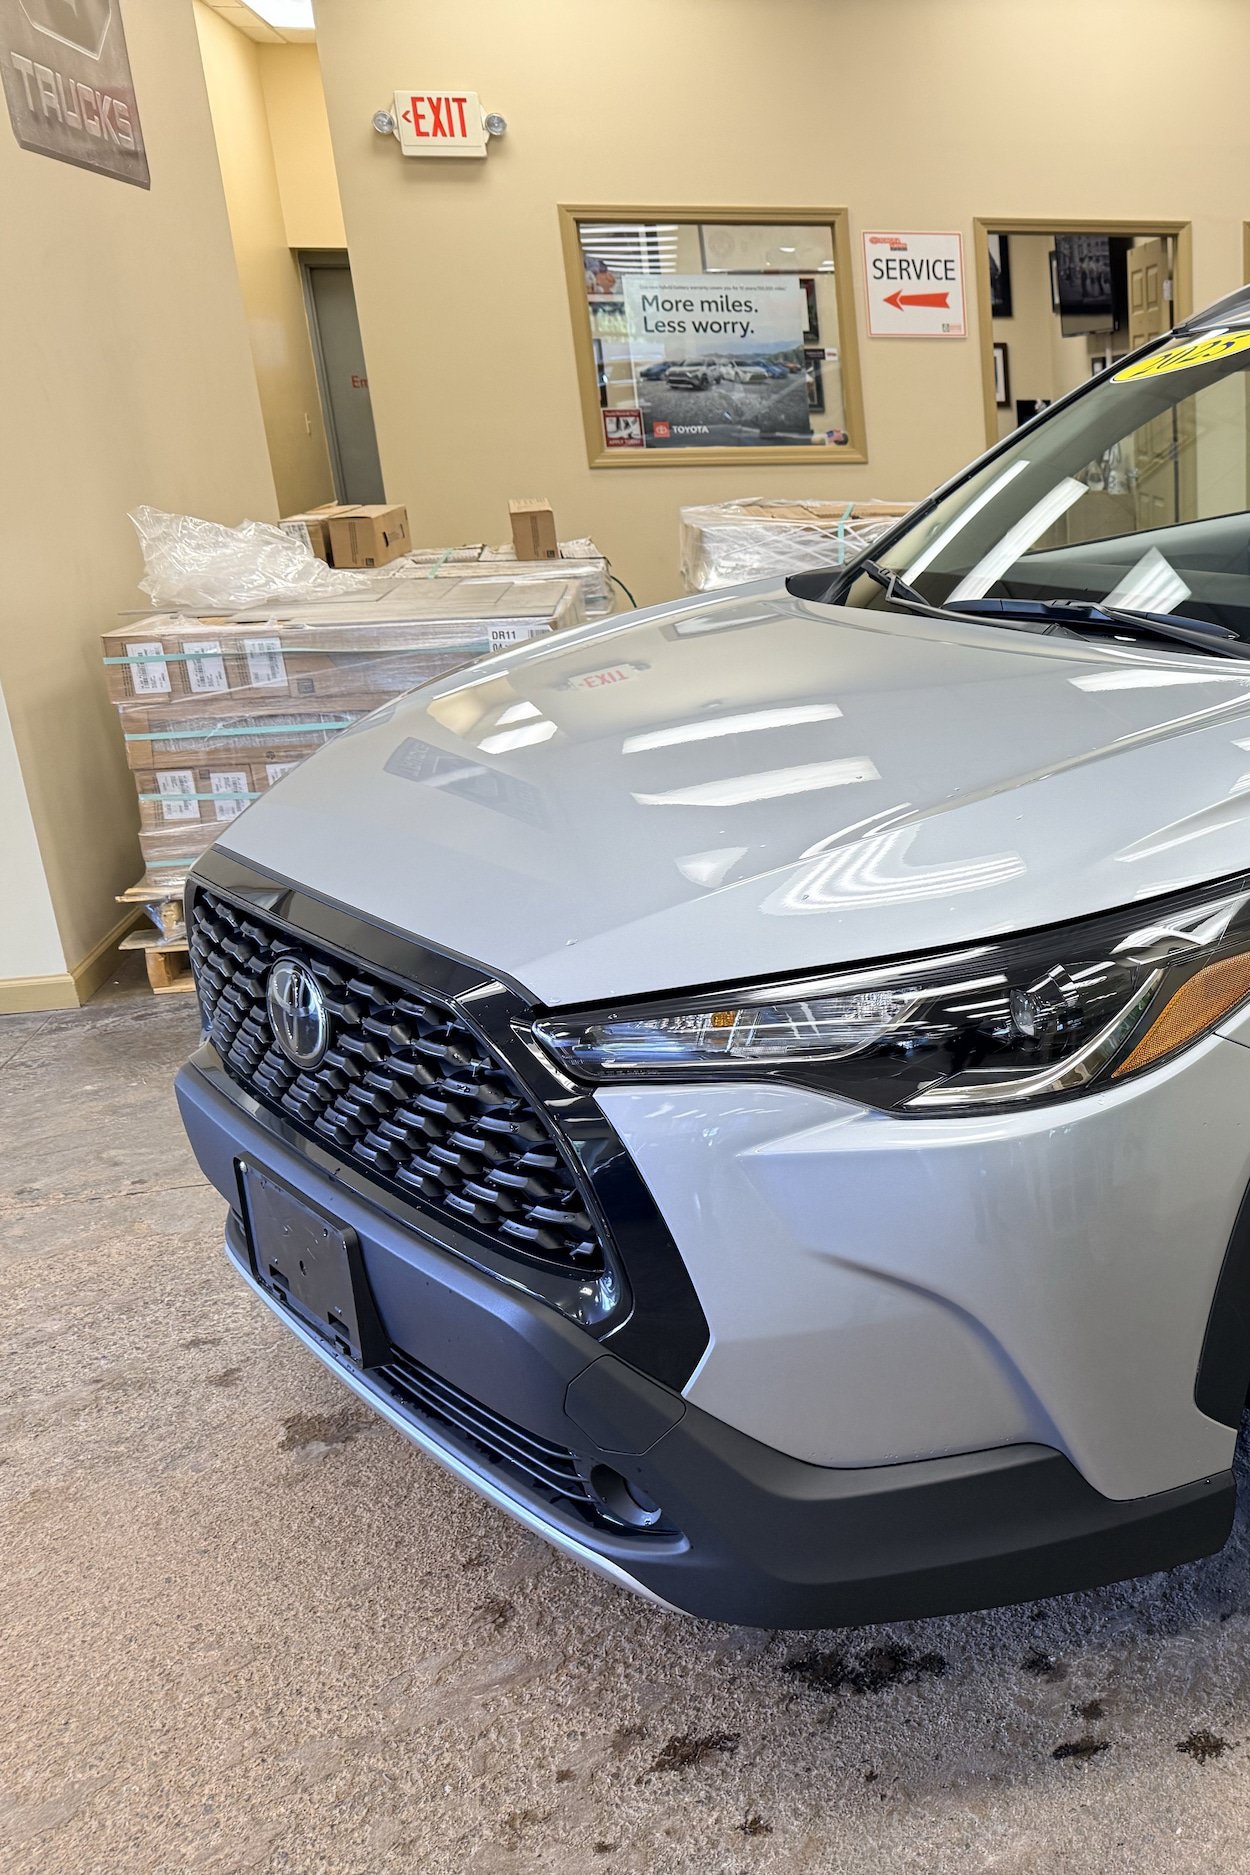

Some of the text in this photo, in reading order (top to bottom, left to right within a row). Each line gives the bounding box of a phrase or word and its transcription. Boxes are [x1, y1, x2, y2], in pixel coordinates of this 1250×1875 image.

[11, 52, 135, 150] TRUCKS
[411, 97, 467, 137] EXIT
[872, 258, 956, 280] SERVICE
[641, 294, 759, 313] More miles.
[643, 316, 755, 338] Less worry.
[672, 425, 709, 434] TOYOTA
[492, 631, 516, 640] DR11
